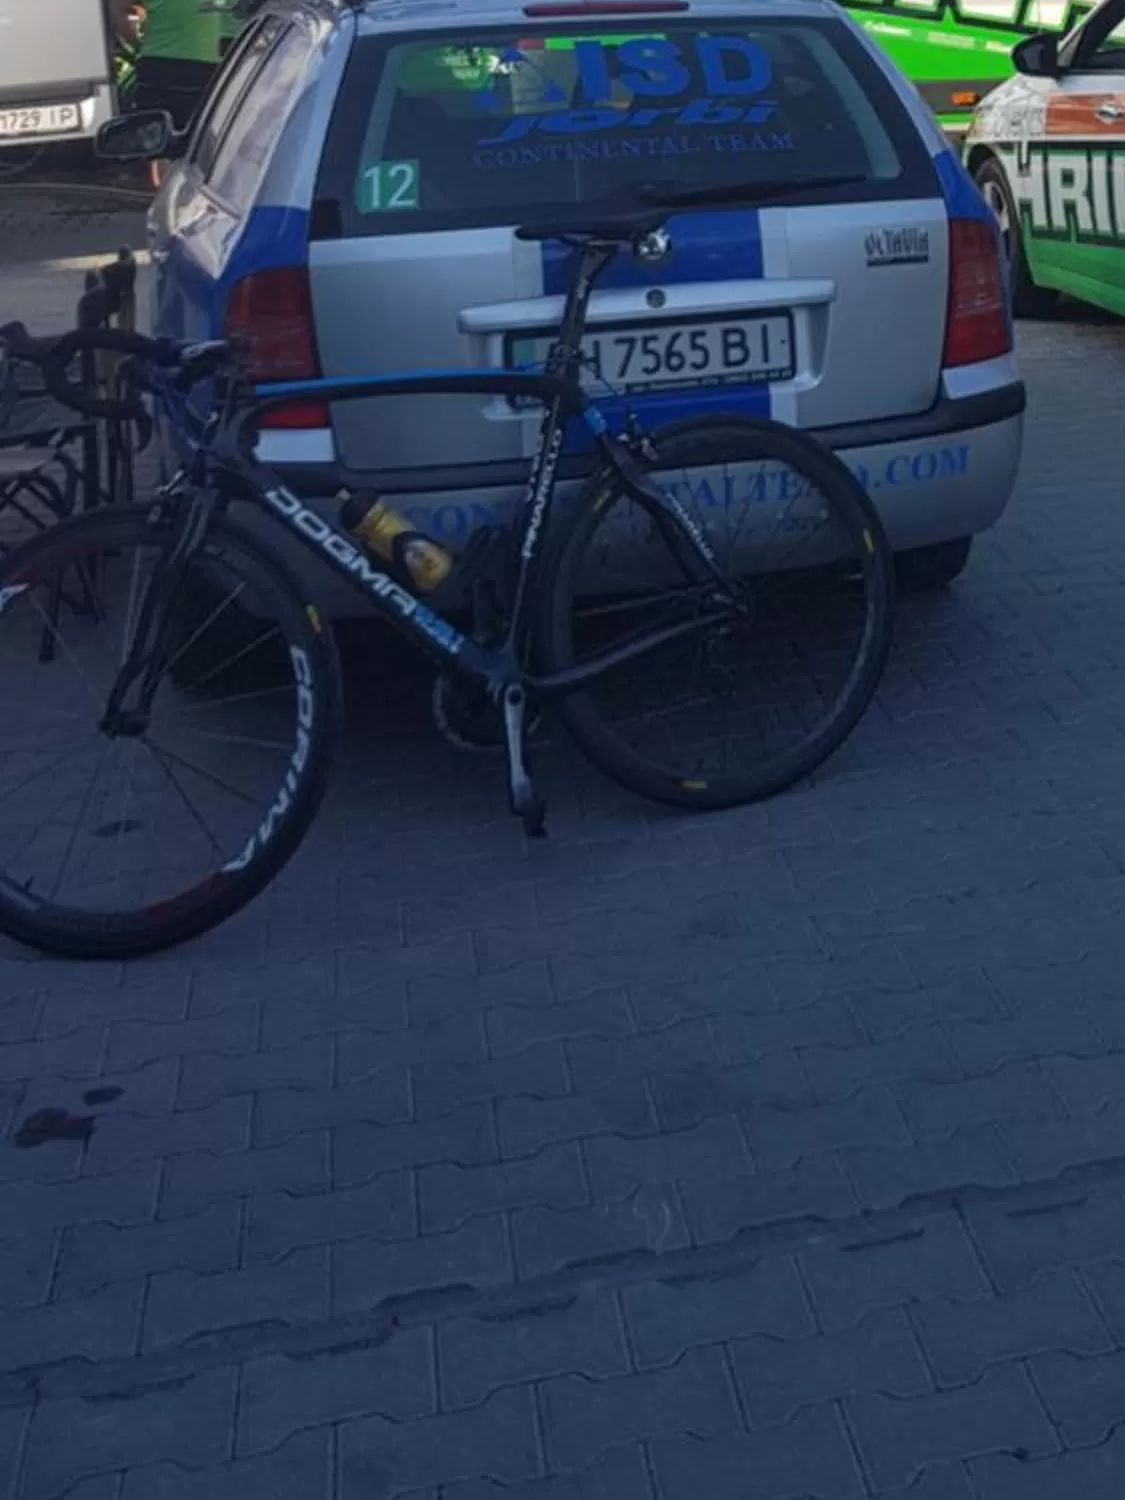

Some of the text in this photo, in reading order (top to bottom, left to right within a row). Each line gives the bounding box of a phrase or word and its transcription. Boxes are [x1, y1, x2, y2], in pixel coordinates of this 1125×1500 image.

[574, 34, 772, 102] ISD
[473, 131, 797, 168] CONTINENTAL TEAM
[362, 165, 415, 208] 12
[613, 329, 710, 379] 7565
[721, 323, 771, 369] BI
[265, 485, 417, 617] DOGMA
[223, 645, 313, 873] CORIMA
